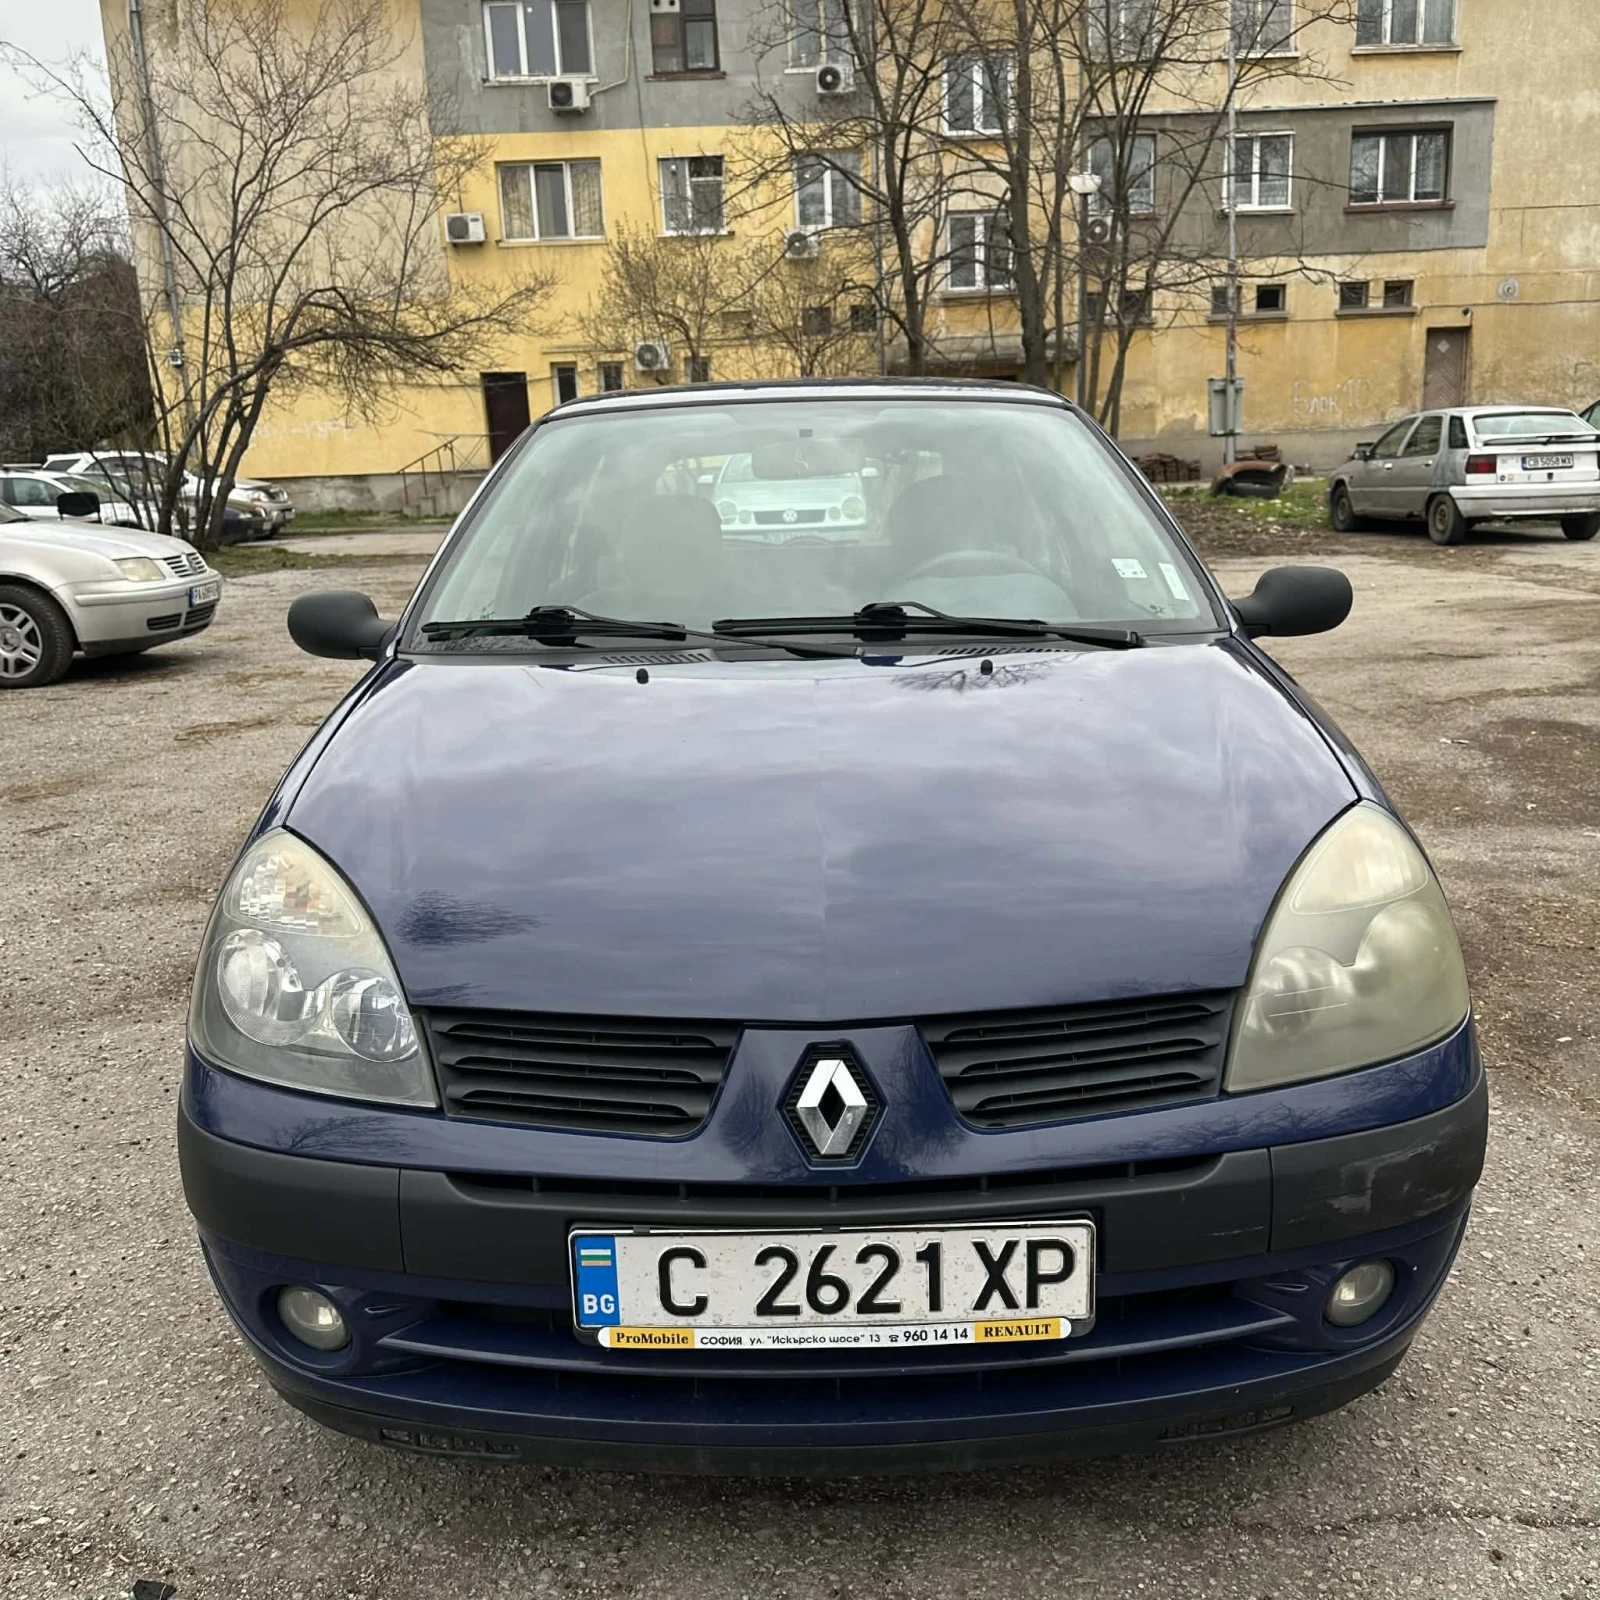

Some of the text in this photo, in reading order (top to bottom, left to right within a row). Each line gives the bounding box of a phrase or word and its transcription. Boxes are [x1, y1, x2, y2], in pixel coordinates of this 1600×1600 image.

[657, 1238, 1077, 1317] C 2621 XP
[583, 1295, 615, 1315] BG
[616, 1332, 689, 1345] ProMobile
[700, 1336, 742, 1346] СОФИЯ
[749, 1337, 765, 1346] ул.
[869, 1334, 881, 1343] 13
[903, 1330, 928, 1342] 960
[933, 1329, 948, 1341] 14
[954, 1328, 969, 1340] 14
[983, 1324, 1051, 1338] RENAULT
